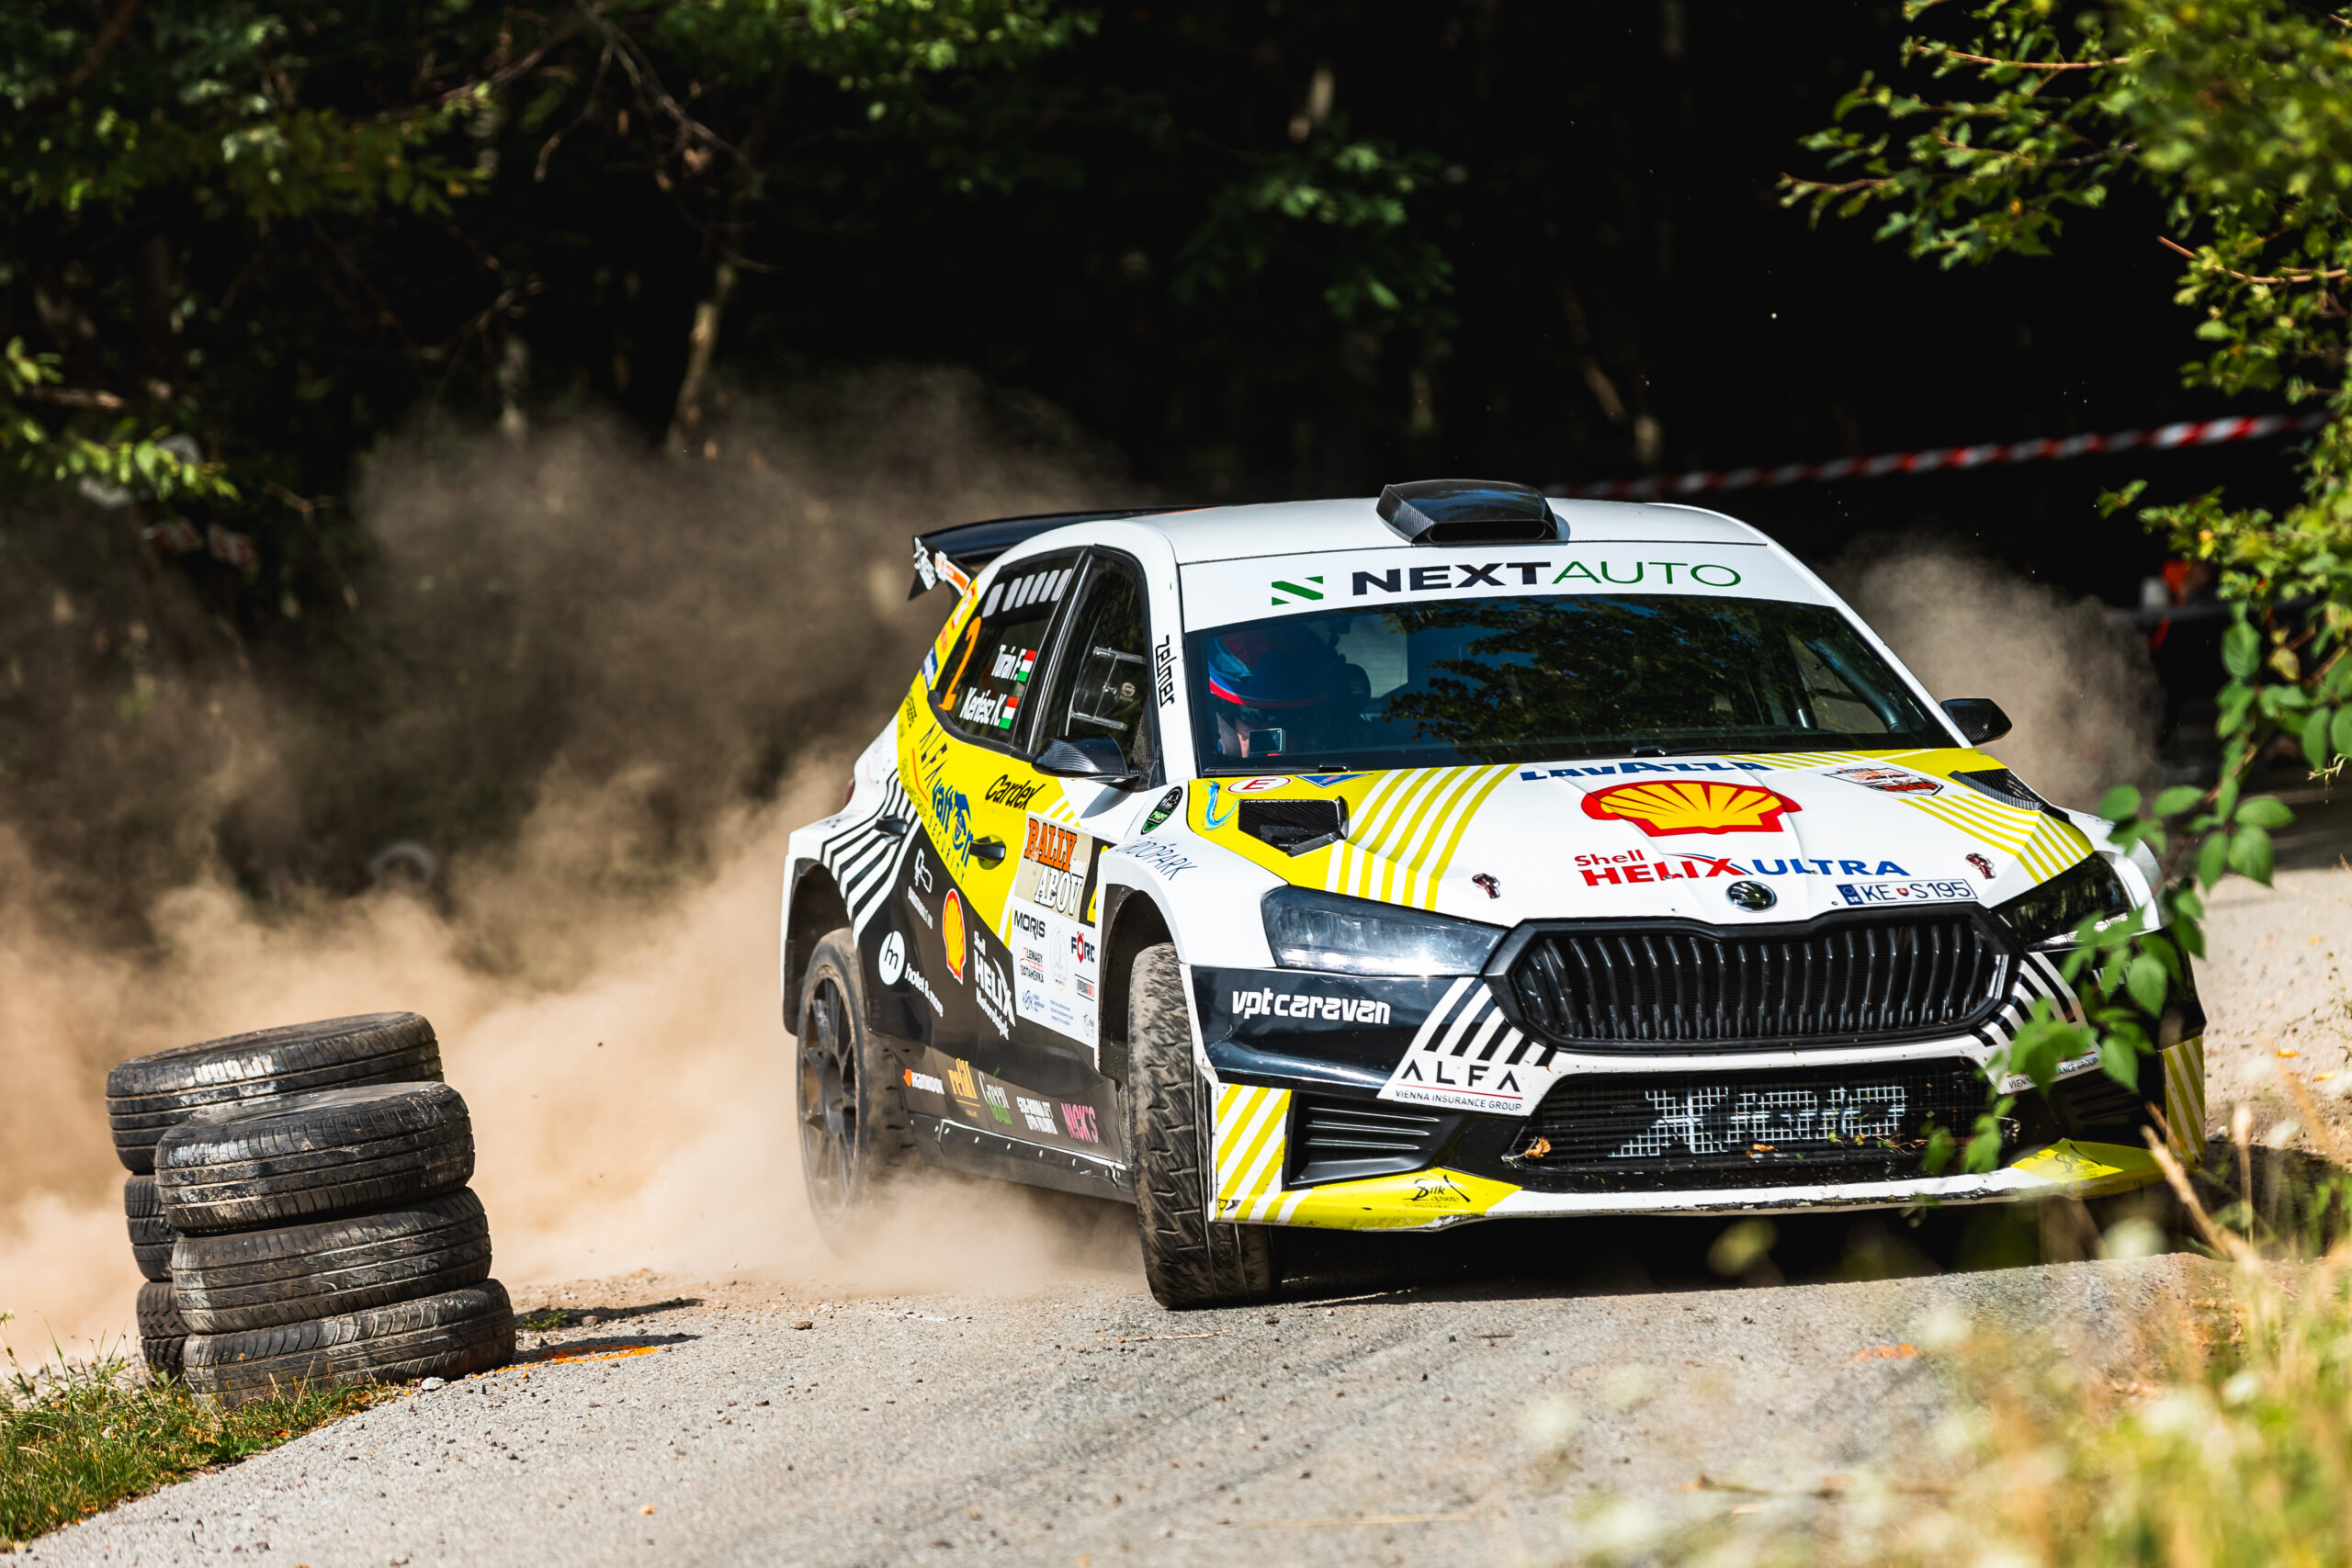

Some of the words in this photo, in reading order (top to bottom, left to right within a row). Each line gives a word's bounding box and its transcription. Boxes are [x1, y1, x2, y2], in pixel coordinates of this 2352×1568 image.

[1352, 560, 1742, 596] NEXTAUTO
[1155, 634, 1177, 708] zelmer
[1242, 779, 1278, 790] E
[1521, 761, 1773, 781] LAVAZZA
[985, 774, 1046, 810] Cardex
[1023, 818, 1078, 872] RALLY
[1575, 850, 1645, 866] Shell
[1578, 852, 1751, 886] HELIX
[1752, 859, 1912, 876] ULTRA
[1034, 866, 1084, 917] ABOV
[1860, 885, 1897, 901] KE
[1910, 882, 1972, 899] S195
[1014, 910, 1046, 941] MORIS
[974, 949, 1016, 1027] HELIX
[1401, 1059, 1521, 1093] ALFA
[2008, 1077, 2035, 1089] VIENN
[1396, 1090, 1430, 1100] VIENNA
[1432, 1094, 1486, 1108] INSURANCE
[1488, 1100, 1521, 1111] GROUP
